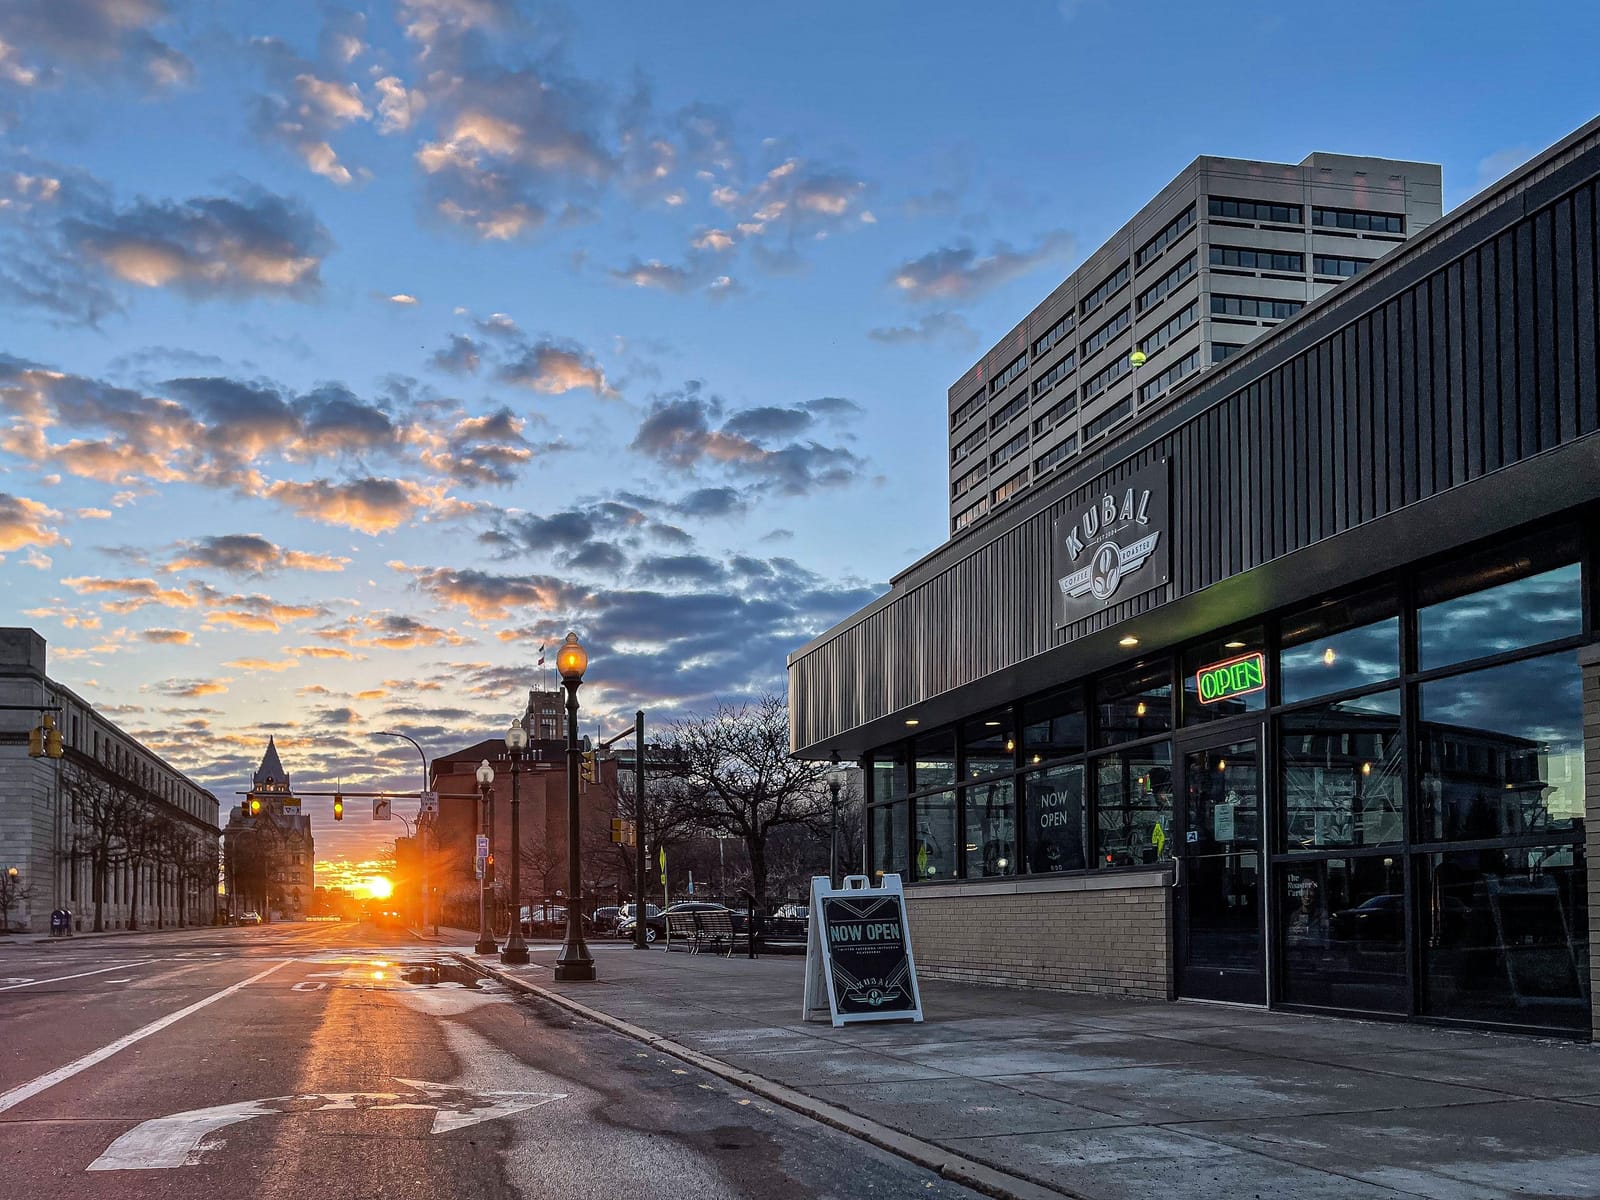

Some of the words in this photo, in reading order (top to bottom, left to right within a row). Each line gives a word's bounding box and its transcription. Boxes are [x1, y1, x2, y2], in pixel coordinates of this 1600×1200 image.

[1065, 488, 1151, 561] KUBAL
[1064, 570, 1088, 588] COFFEE
[1122, 541, 1150, 560] ROASTER
[1201, 657, 1262, 699] OPEN
[1041, 790, 1069, 808] NOW
[1040, 810, 1068, 828] OPEN
[1287, 873, 1300, 882] The
[830, 924, 862, 942] NOW
[866, 923, 901, 940] OPEN
[856, 977, 890, 990] KUBAL
